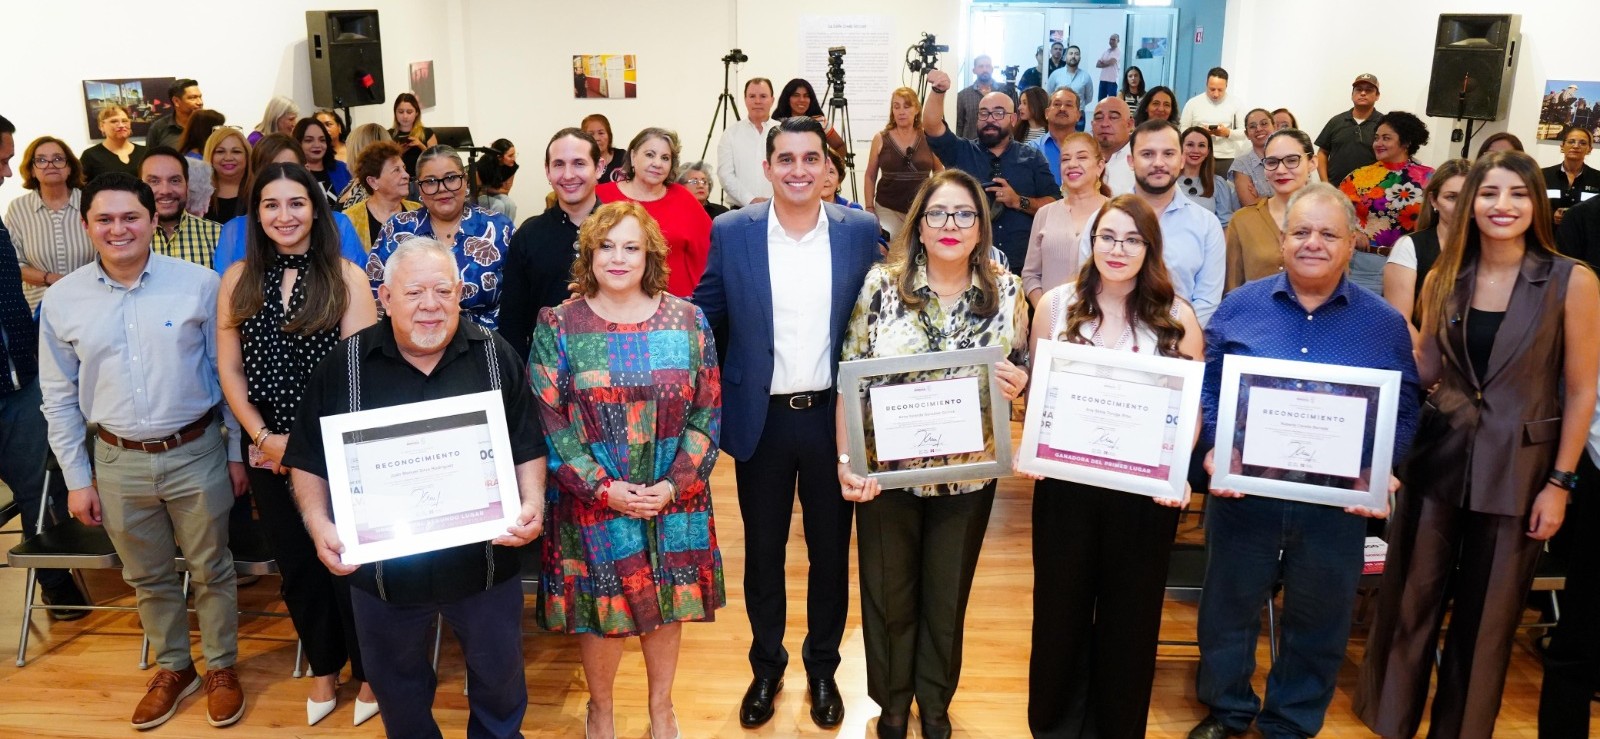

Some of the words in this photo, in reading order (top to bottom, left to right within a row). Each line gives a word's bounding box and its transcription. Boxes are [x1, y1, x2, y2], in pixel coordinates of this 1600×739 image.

[885, 398, 962, 411] RECONOCIMIENTO
[1071, 394, 1149, 412] RECONOCIMIENTO
[1262, 409, 1345, 423] RECONOCIMIENTO
[375, 450, 460, 470] RECONOCIMIENTO
[1054, 452, 1090, 463] GANADORA
[1103, 461, 1128, 470] PRIMER
[1129, 465, 1152, 474] LUGAR
